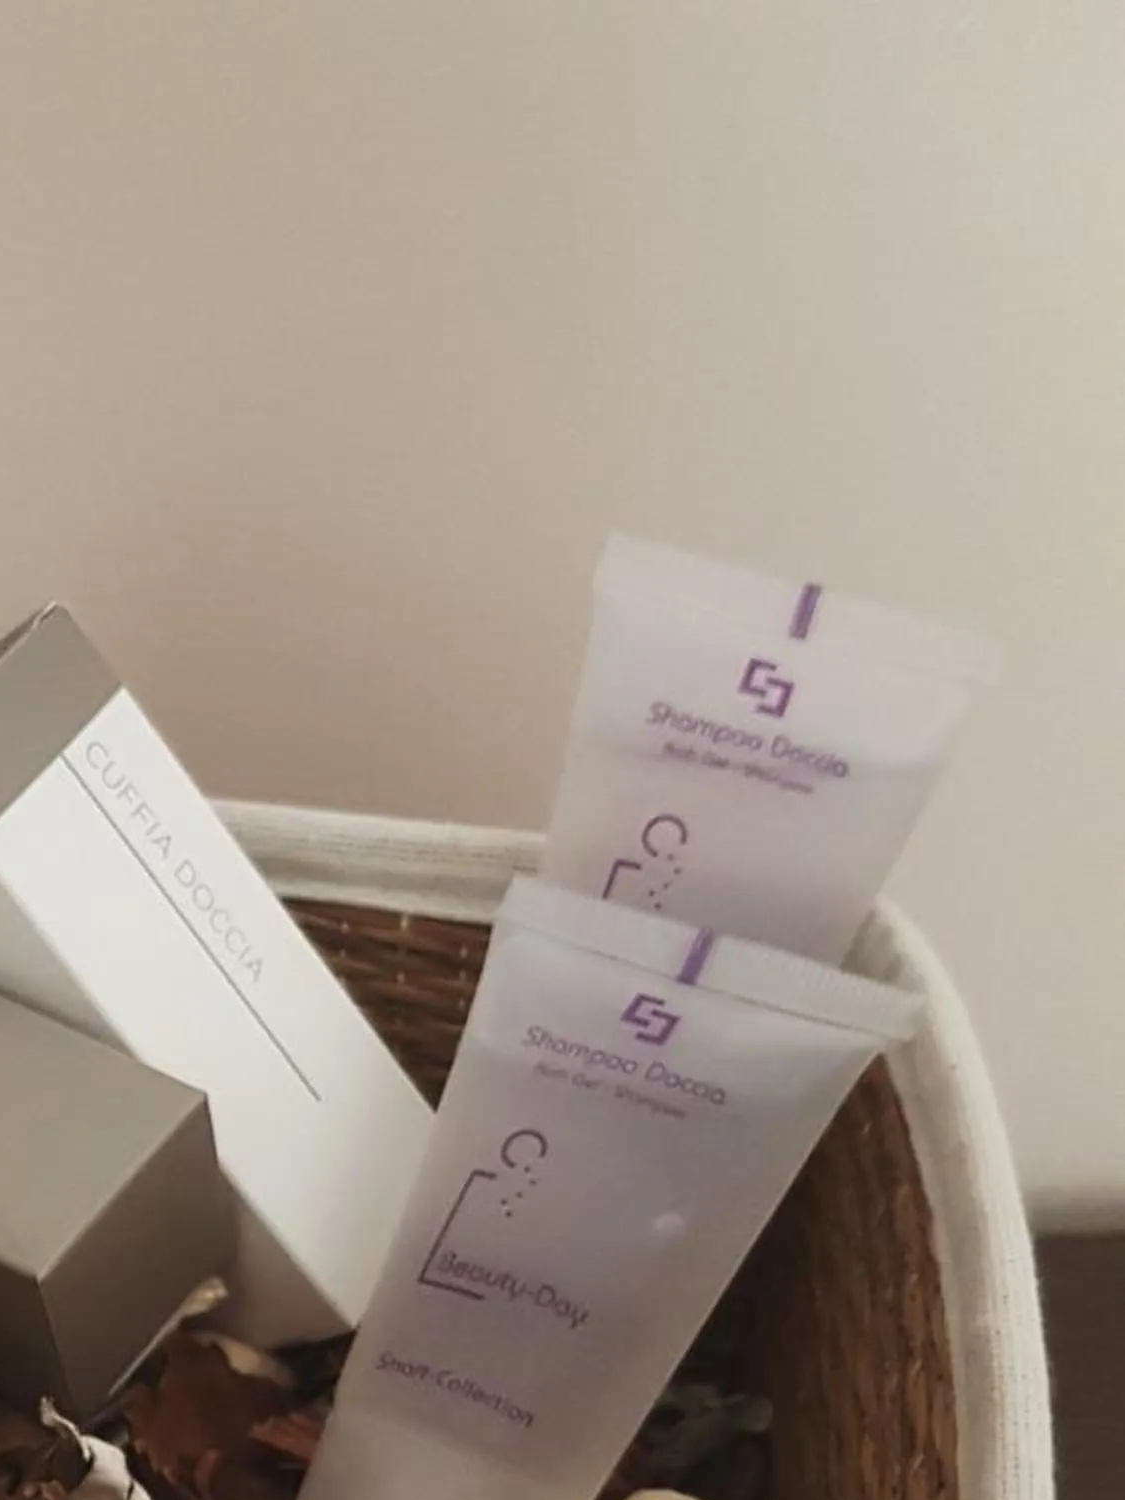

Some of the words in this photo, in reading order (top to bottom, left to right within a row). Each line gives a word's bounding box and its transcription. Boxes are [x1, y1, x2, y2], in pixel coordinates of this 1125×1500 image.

[645, 701, 764, 752] Shampoo
[770, 735, 850, 779] Doccia
[85, 740, 172, 859] CUFFIA
[173, 859, 265, 984] DOCCIA
[521, 1025, 638, 1077] Shampoo
[643, 1060, 727, 1106] Doccia
[437, 1250, 590, 1330] Beauty-Day
